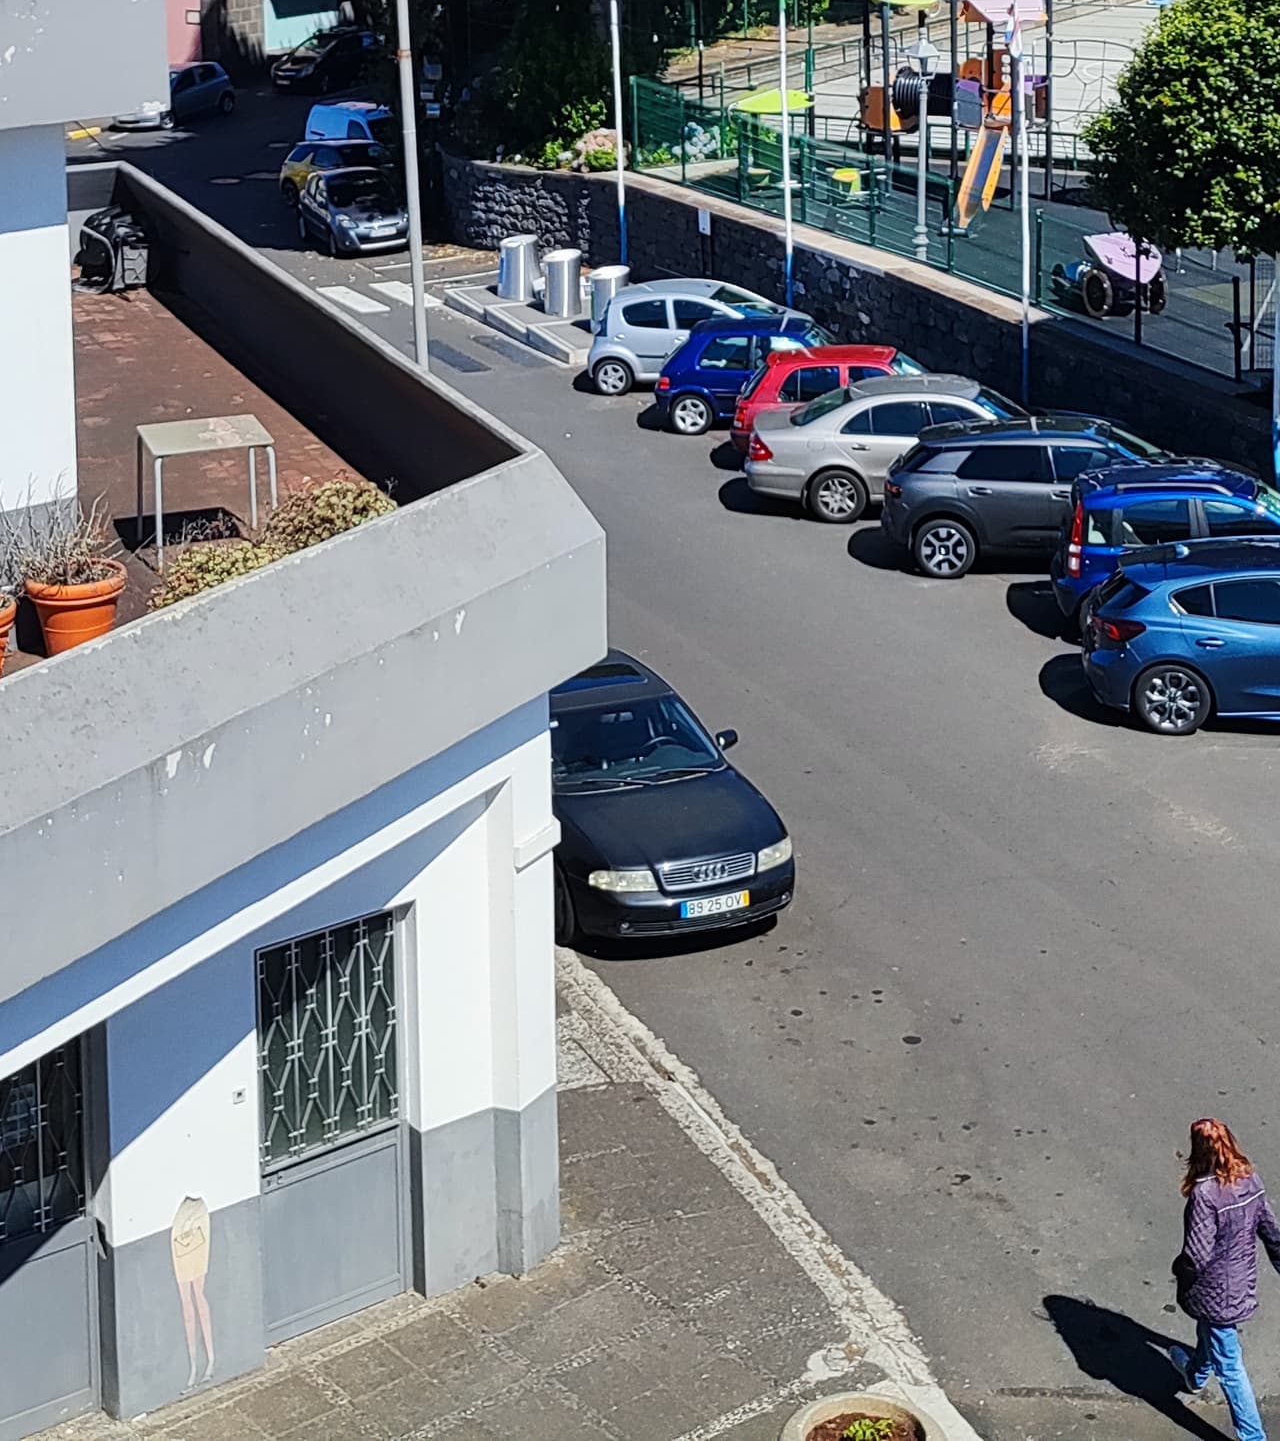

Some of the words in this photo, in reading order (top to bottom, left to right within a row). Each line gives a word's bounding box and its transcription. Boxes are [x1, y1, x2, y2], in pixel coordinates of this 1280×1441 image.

[688, 901, 704, 915] 89
[707, 898, 722, 912] 25
[725, 893, 742, 908] OV
